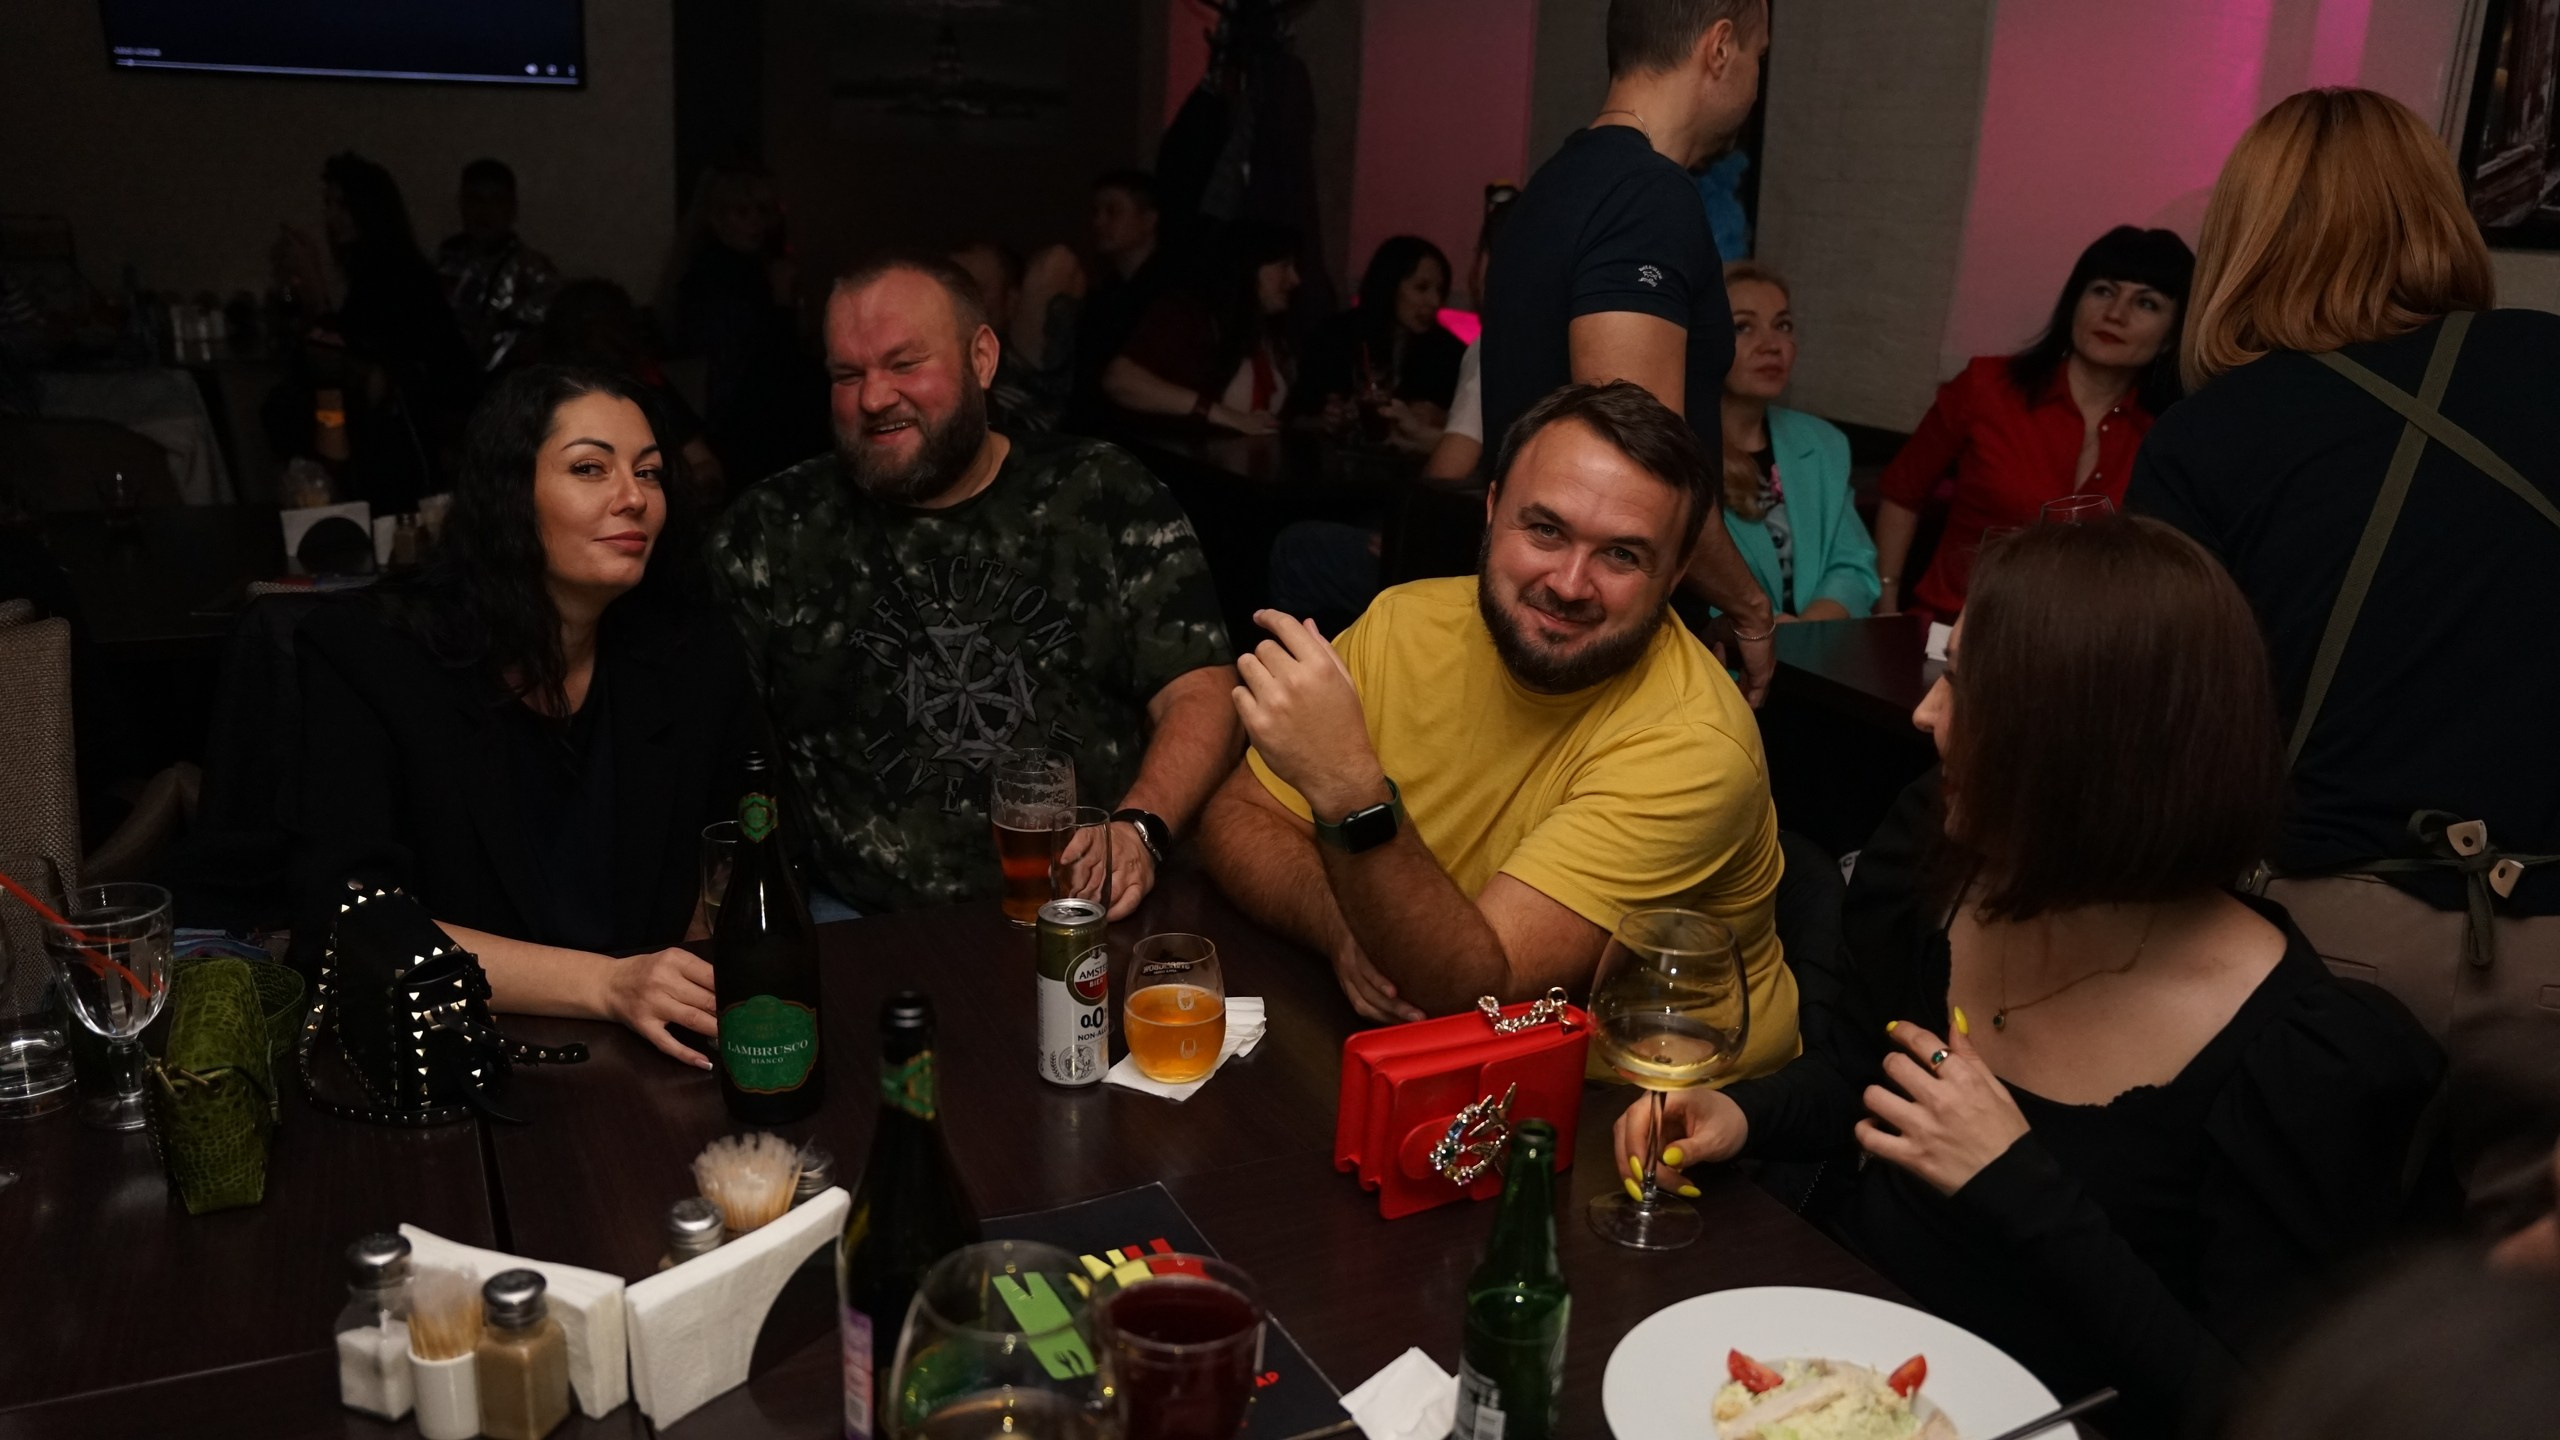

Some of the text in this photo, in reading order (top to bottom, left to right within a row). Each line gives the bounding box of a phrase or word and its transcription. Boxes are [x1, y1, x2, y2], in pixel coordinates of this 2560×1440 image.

[862, 729, 964, 816] LIVE
[727, 1039, 809, 1057] LAMBRUSCO
[751, 1057, 784, 1065] BIANCO
